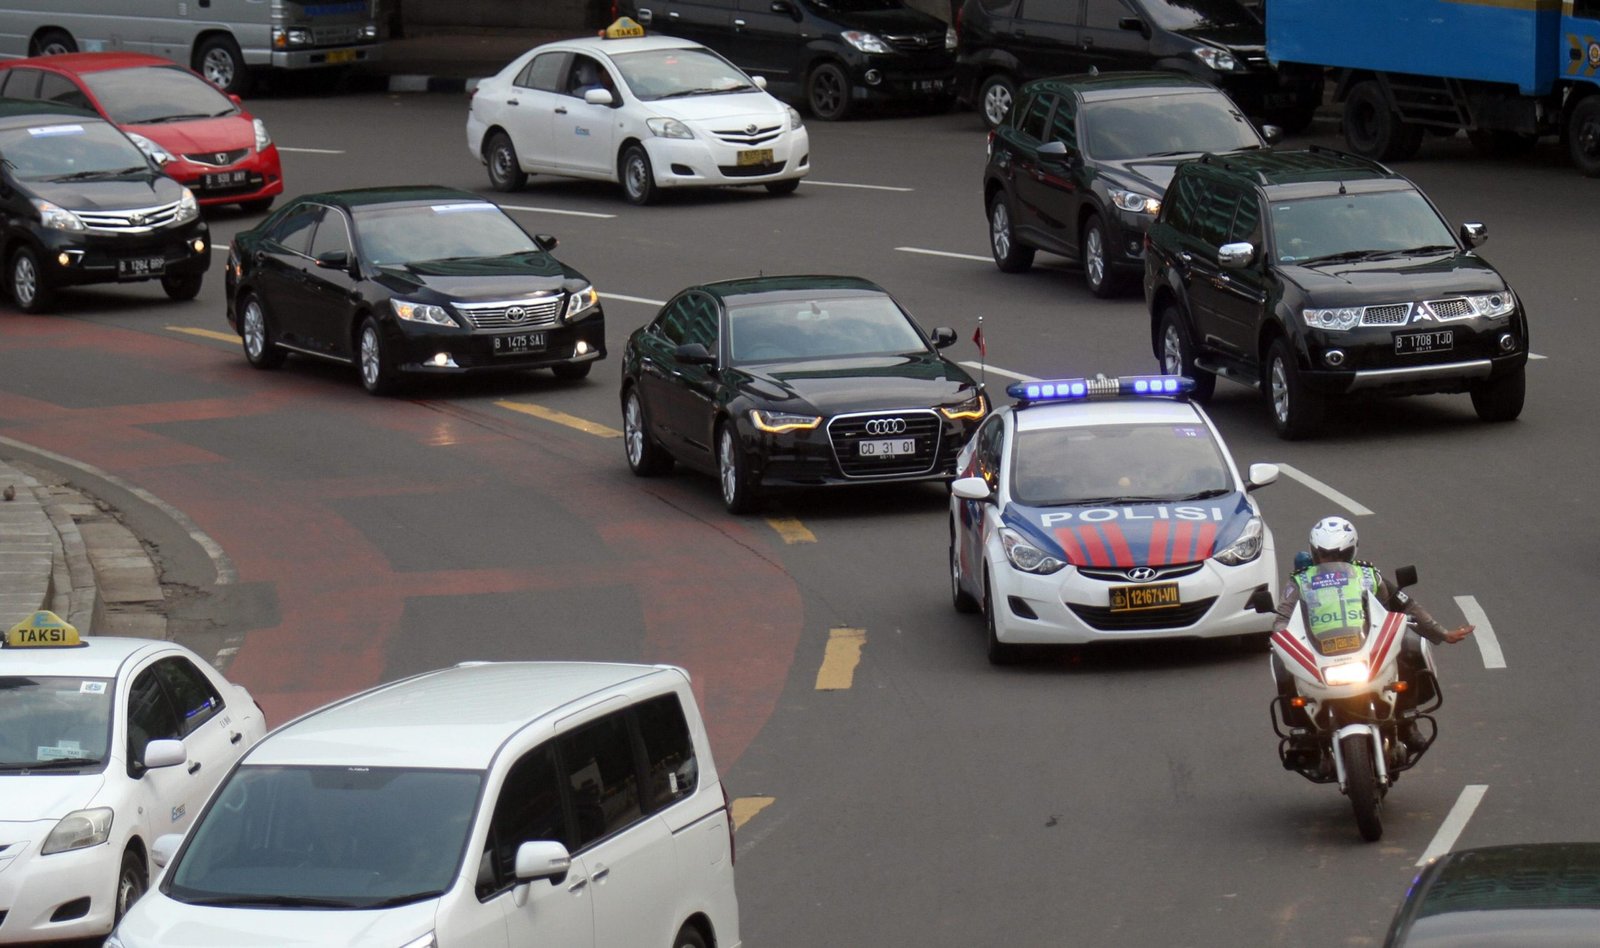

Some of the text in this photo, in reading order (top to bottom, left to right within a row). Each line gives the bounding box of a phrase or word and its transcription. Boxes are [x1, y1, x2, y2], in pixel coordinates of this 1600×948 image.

[615, 28, 642, 37] TAKSI
[119, 260, 126, 272] B
[494, 334, 544, 349] B 1475 SAI
[1396, 337, 1403, 349] B
[1411, 334, 1432, 348] 1708
[1435, 332, 1452, 345] TJD
[861, 441, 914, 455] CD 31 01
[1040, 506, 1223, 528] POLISI
[1130, 586, 1178, 606] 121671-VII
[1310, 609, 1365, 627] POLSI
[18, 629, 66, 642] TAKSI
